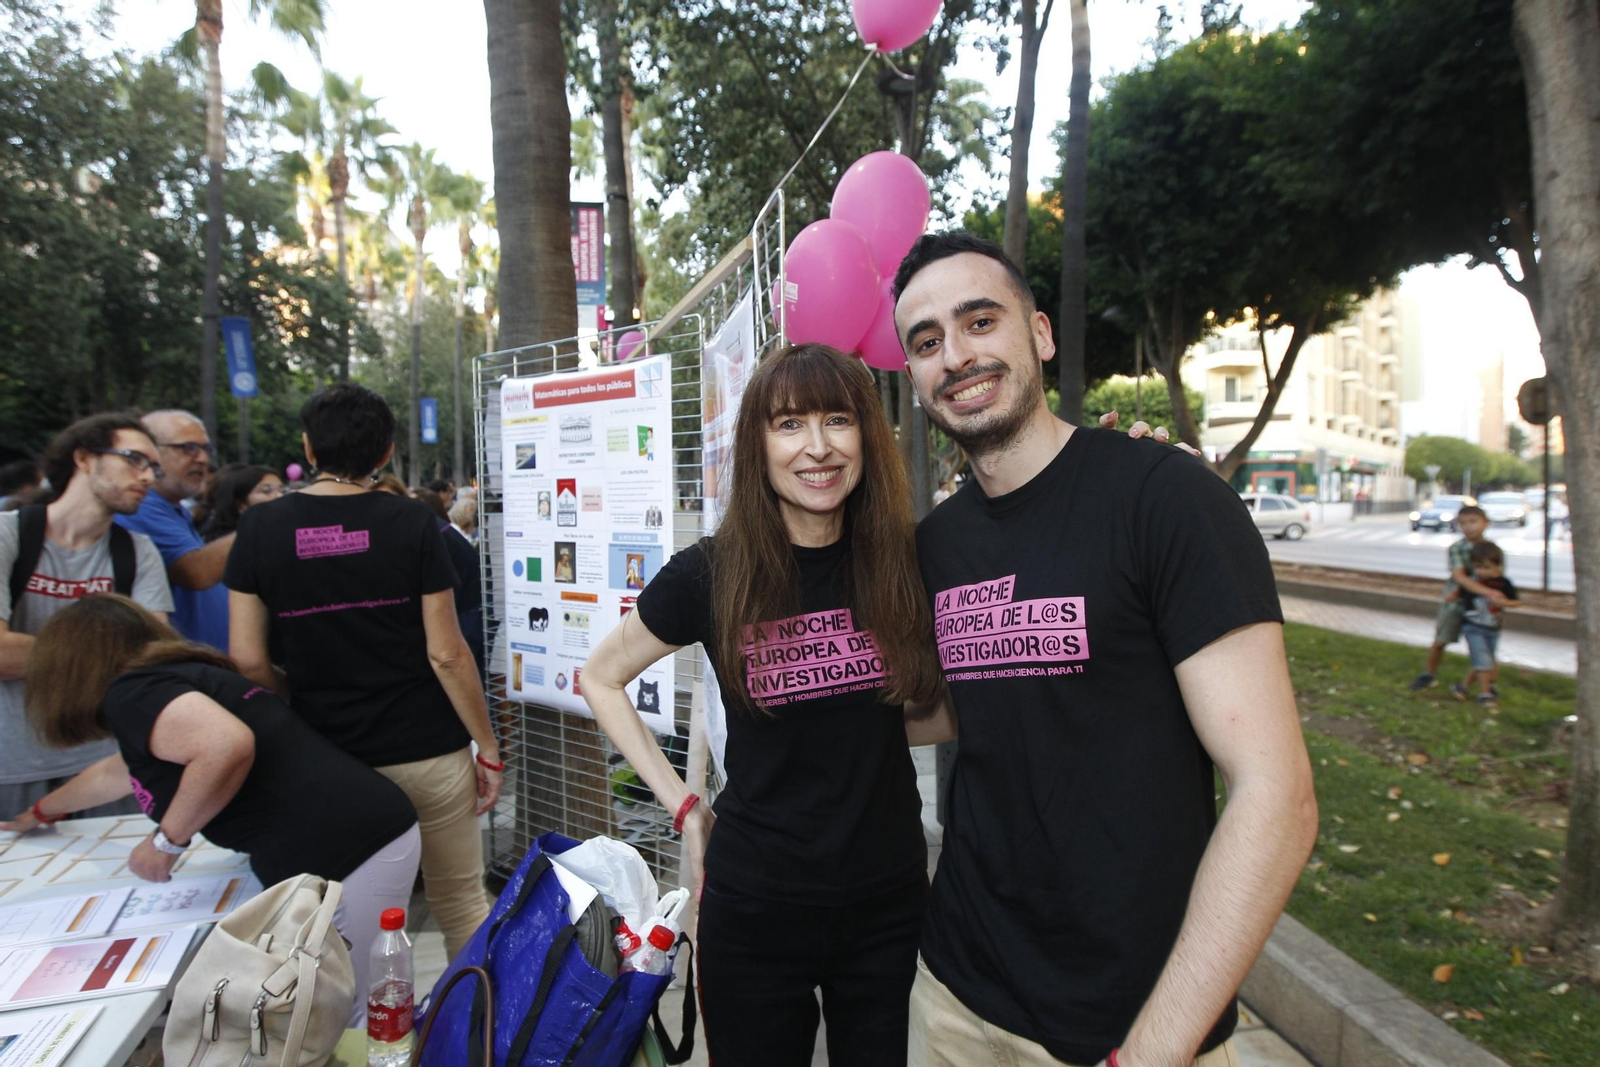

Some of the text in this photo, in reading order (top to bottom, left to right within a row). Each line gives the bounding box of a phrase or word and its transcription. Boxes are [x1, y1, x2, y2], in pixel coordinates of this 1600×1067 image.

[535, 388, 567, 400] Matemáticas
[568, 388, 580, 396] para
[580, 384, 596, 393] todos
[607, 380, 632, 392] públicos
[936, 580, 1010, 613] LA NOCHE
[778, 613, 848, 639] NOCHE
[935, 602, 1077, 639] EUROPEA DE L@S
[746, 633, 874, 668] EUROPEA DE
[955, 671, 982, 680] HOMBRES
[983, 670, 996, 678] QUE
[996, 670, 1015, 678] HACEN
[1015, 667, 1046, 676] CIENCIA
[1048, 666, 1073, 675] PARA
[795, 689, 833, 701] HOMBRES
[834, 686, 849, 695] QUE
[850, 682, 874, 692] HACEN
